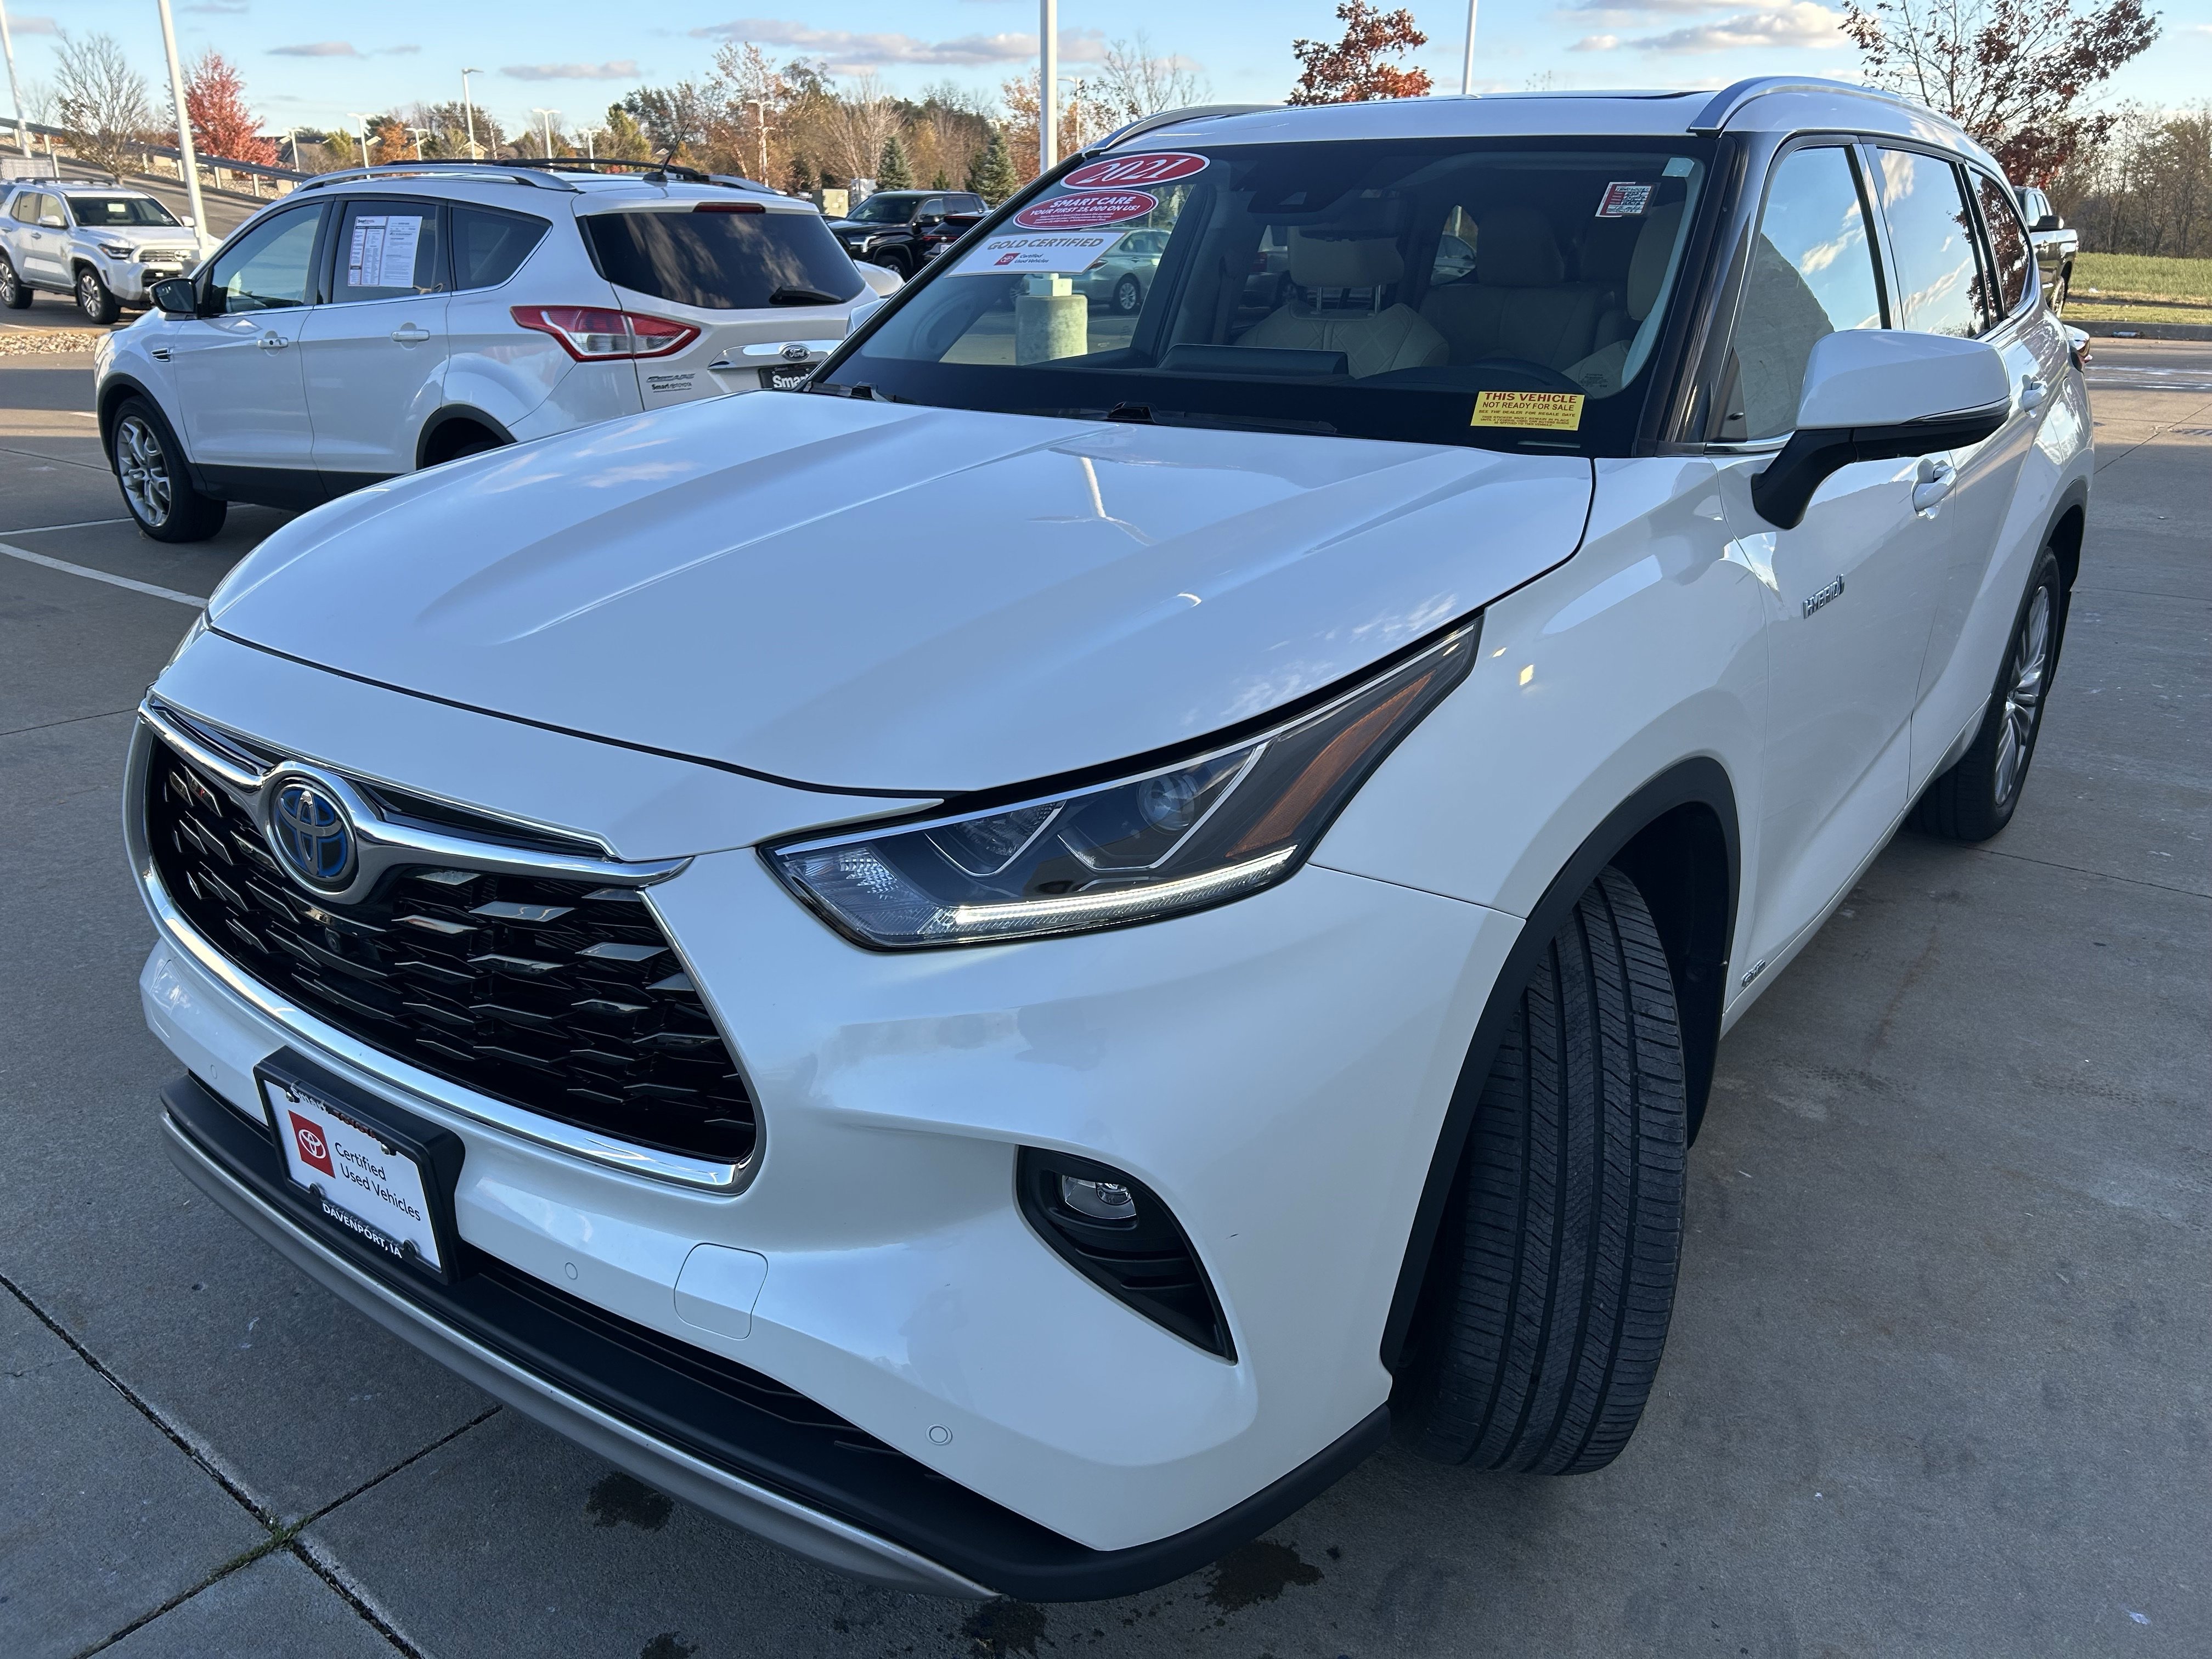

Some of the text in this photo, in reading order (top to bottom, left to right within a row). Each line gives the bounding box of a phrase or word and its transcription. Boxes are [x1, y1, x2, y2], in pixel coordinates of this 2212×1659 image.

[1076, 157, 1191, 184] 2021
[1049, 196, 1137, 208] SMART CARE
[987, 238, 1104, 251] GOLD CERTIFIED
[789, 348, 805, 358] Ford
[1485, 392, 1578, 403] THIS VEHICLE
[1802, 580, 1841, 619] HYBRID
[334, 1142, 387, 1182] Certified
[340, 1163, 422, 1222] Used Vehicles
[323, 1203, 403, 1259] DAVENPORT, IA
